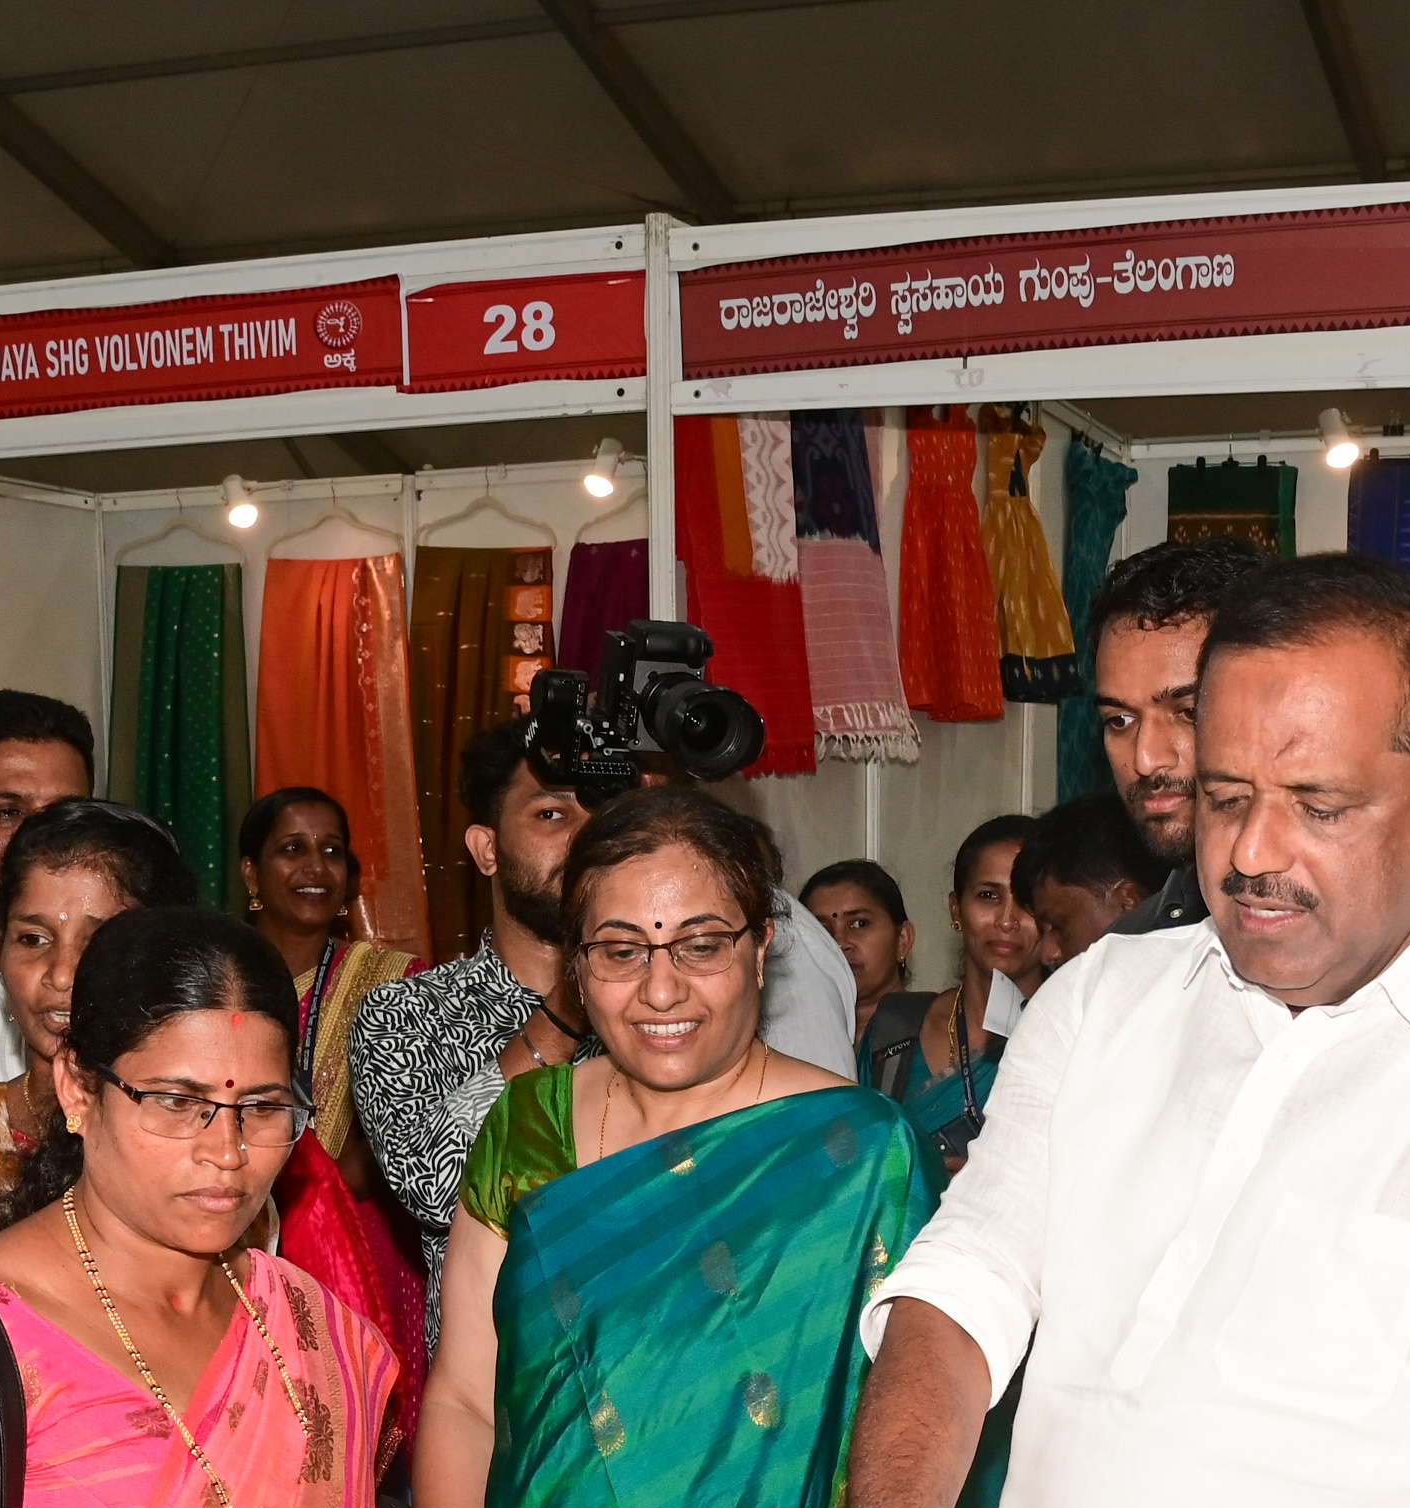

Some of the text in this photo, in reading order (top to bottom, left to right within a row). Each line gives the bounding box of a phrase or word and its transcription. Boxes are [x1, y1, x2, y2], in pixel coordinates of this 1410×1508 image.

[483, 300, 557, 356] 28
[719, 276, 877, 340] ರಾಜರಾಜೇಶ್ವರಿ
[890, 262, 1005, 335] ಸ್ವಸಹಾಯ
[45, 337, 89, 378] SHG
[94, 325, 215, 374] VOLVONEM
[218, 317, 298, 362] THIVIM
